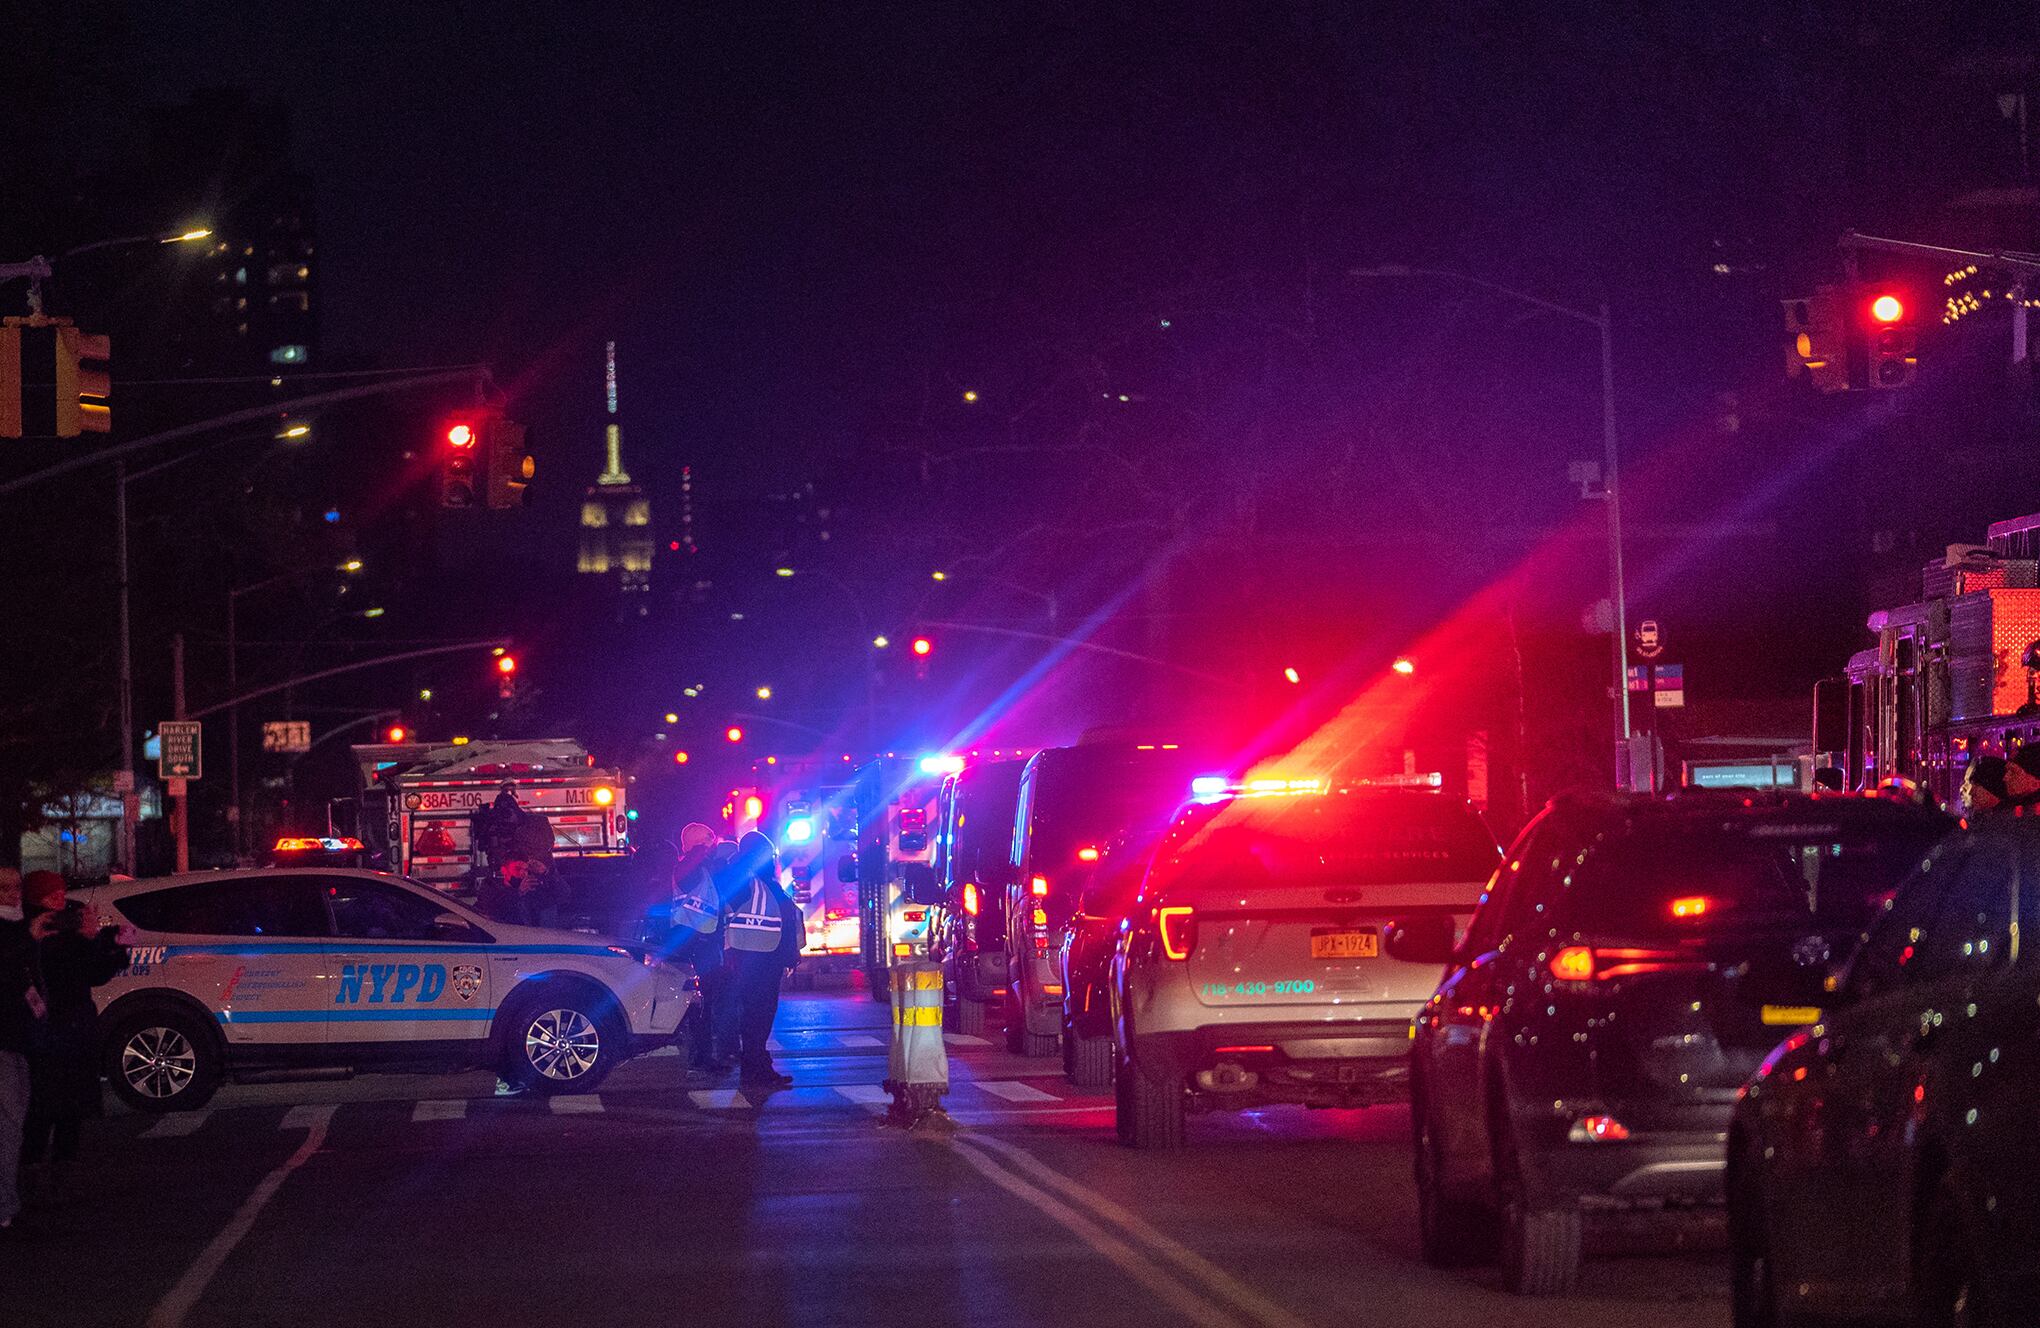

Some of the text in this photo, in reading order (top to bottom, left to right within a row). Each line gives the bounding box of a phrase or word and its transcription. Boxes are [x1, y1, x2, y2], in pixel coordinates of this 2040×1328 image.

[163, 726, 197, 734] HARLEM
[168, 735, 193, 743] RIVER
[168, 745, 193, 753] DRIVE
[168, 754, 194, 763] SOUTH
[423, 792, 482, 808] 38AF-106
[693, 901, 708, 911] NY
[746, 918, 764, 926] NY
[126, 945, 168, 965] FFIC
[335, 964, 448, 1004] NYPD
[1201, 979, 1315, 996] 718-430-9700
